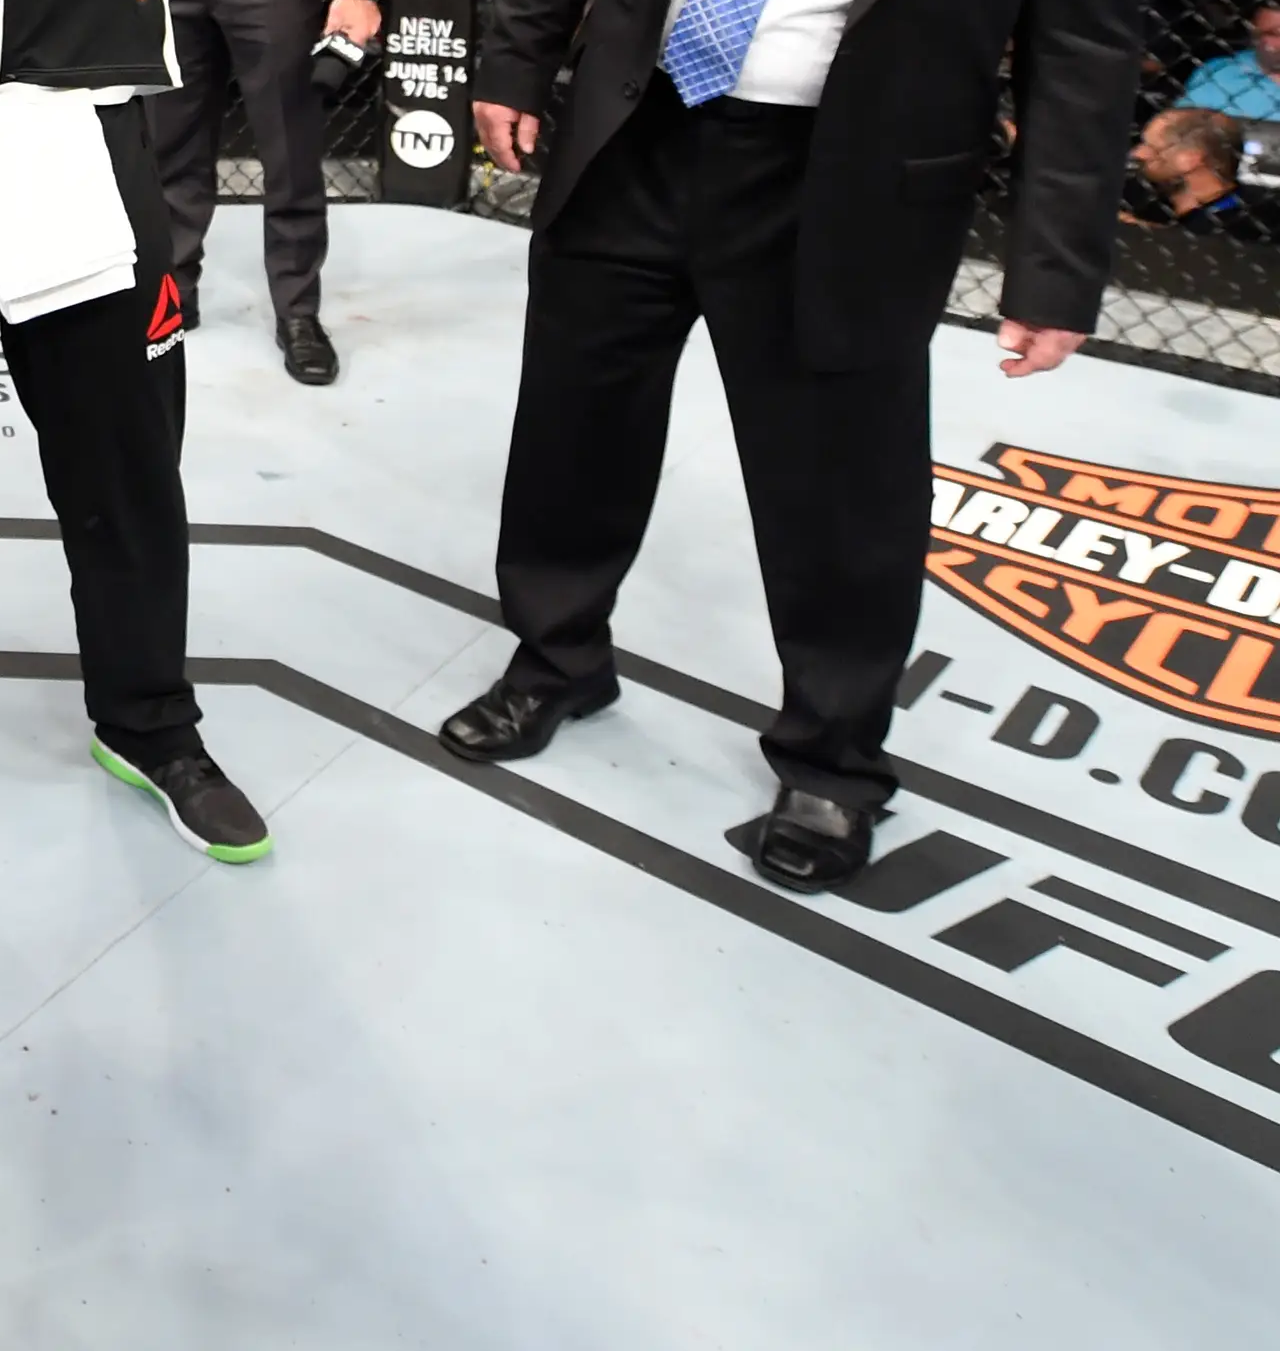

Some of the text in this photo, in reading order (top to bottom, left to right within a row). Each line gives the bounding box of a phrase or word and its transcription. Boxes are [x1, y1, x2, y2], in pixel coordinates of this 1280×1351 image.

[399, 16, 454, 38] NEW
[386, 33, 468, 69] SERIES
[385, 61, 468, 84] JUNE 14
[391, 130, 453, 151] TNT
[146, 328, 185, 361] Reebo
